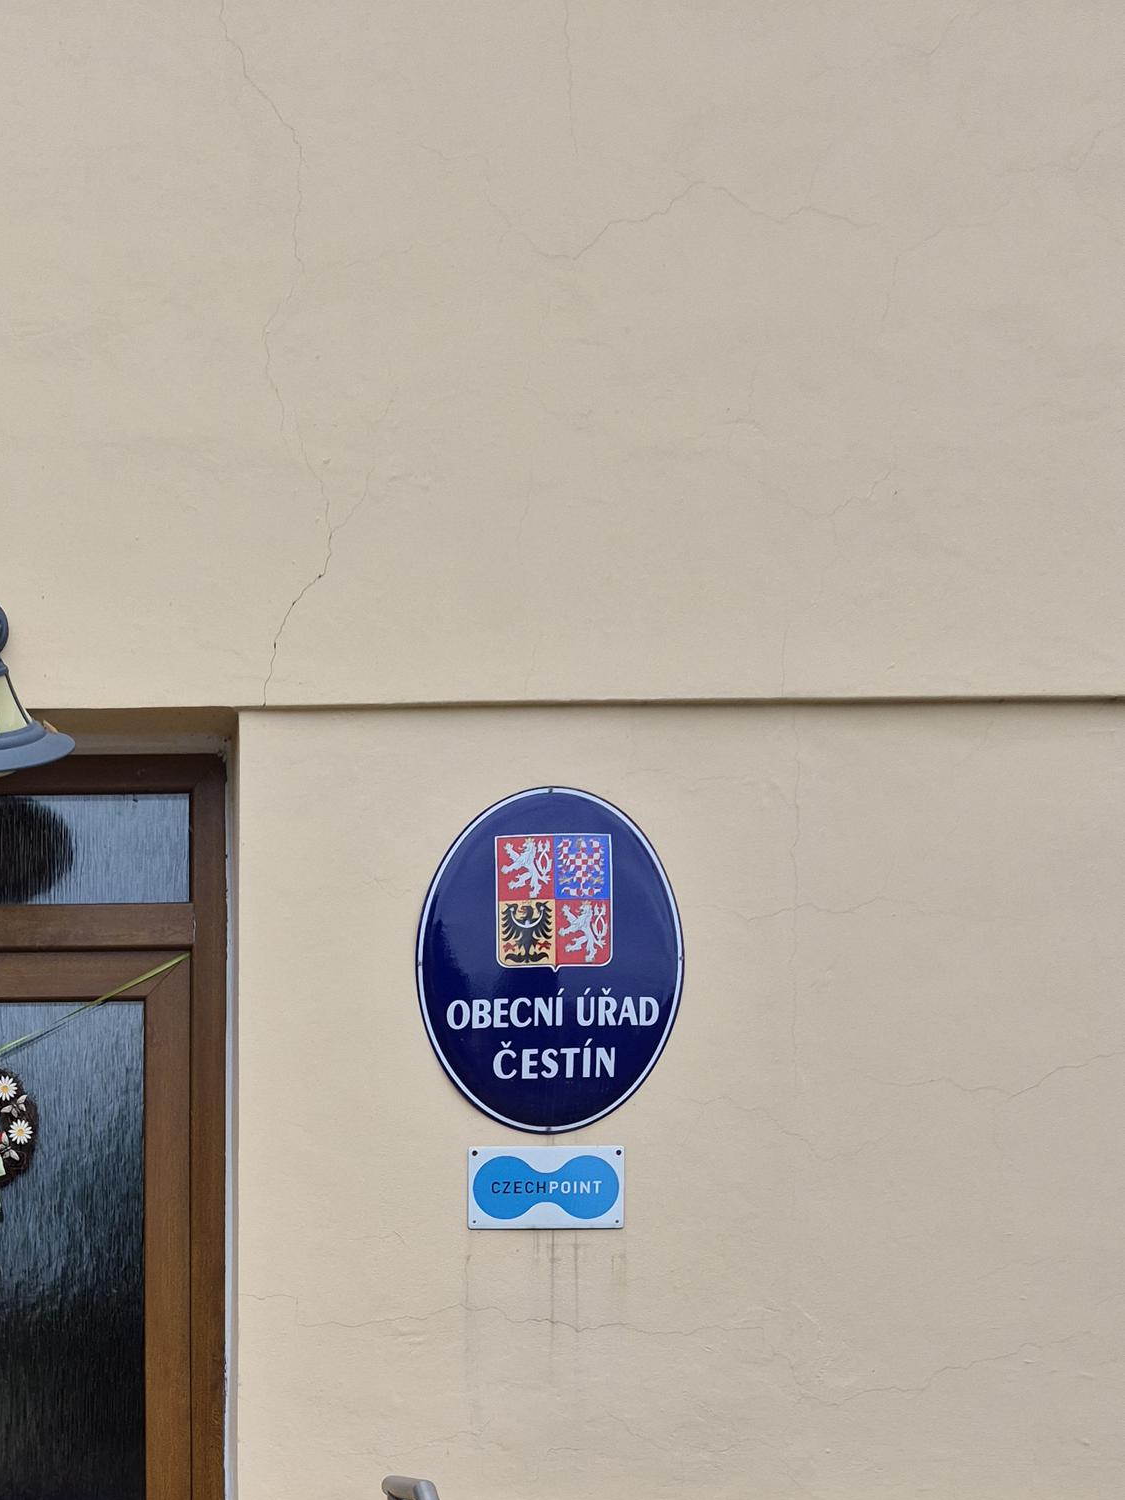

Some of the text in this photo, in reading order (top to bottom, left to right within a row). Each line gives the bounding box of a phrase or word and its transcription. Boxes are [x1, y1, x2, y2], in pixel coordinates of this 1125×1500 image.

[446, 987, 660, 1030] OBECNÍ ÚŘAD
[492, 1038, 616, 1079] ČESTÍN
